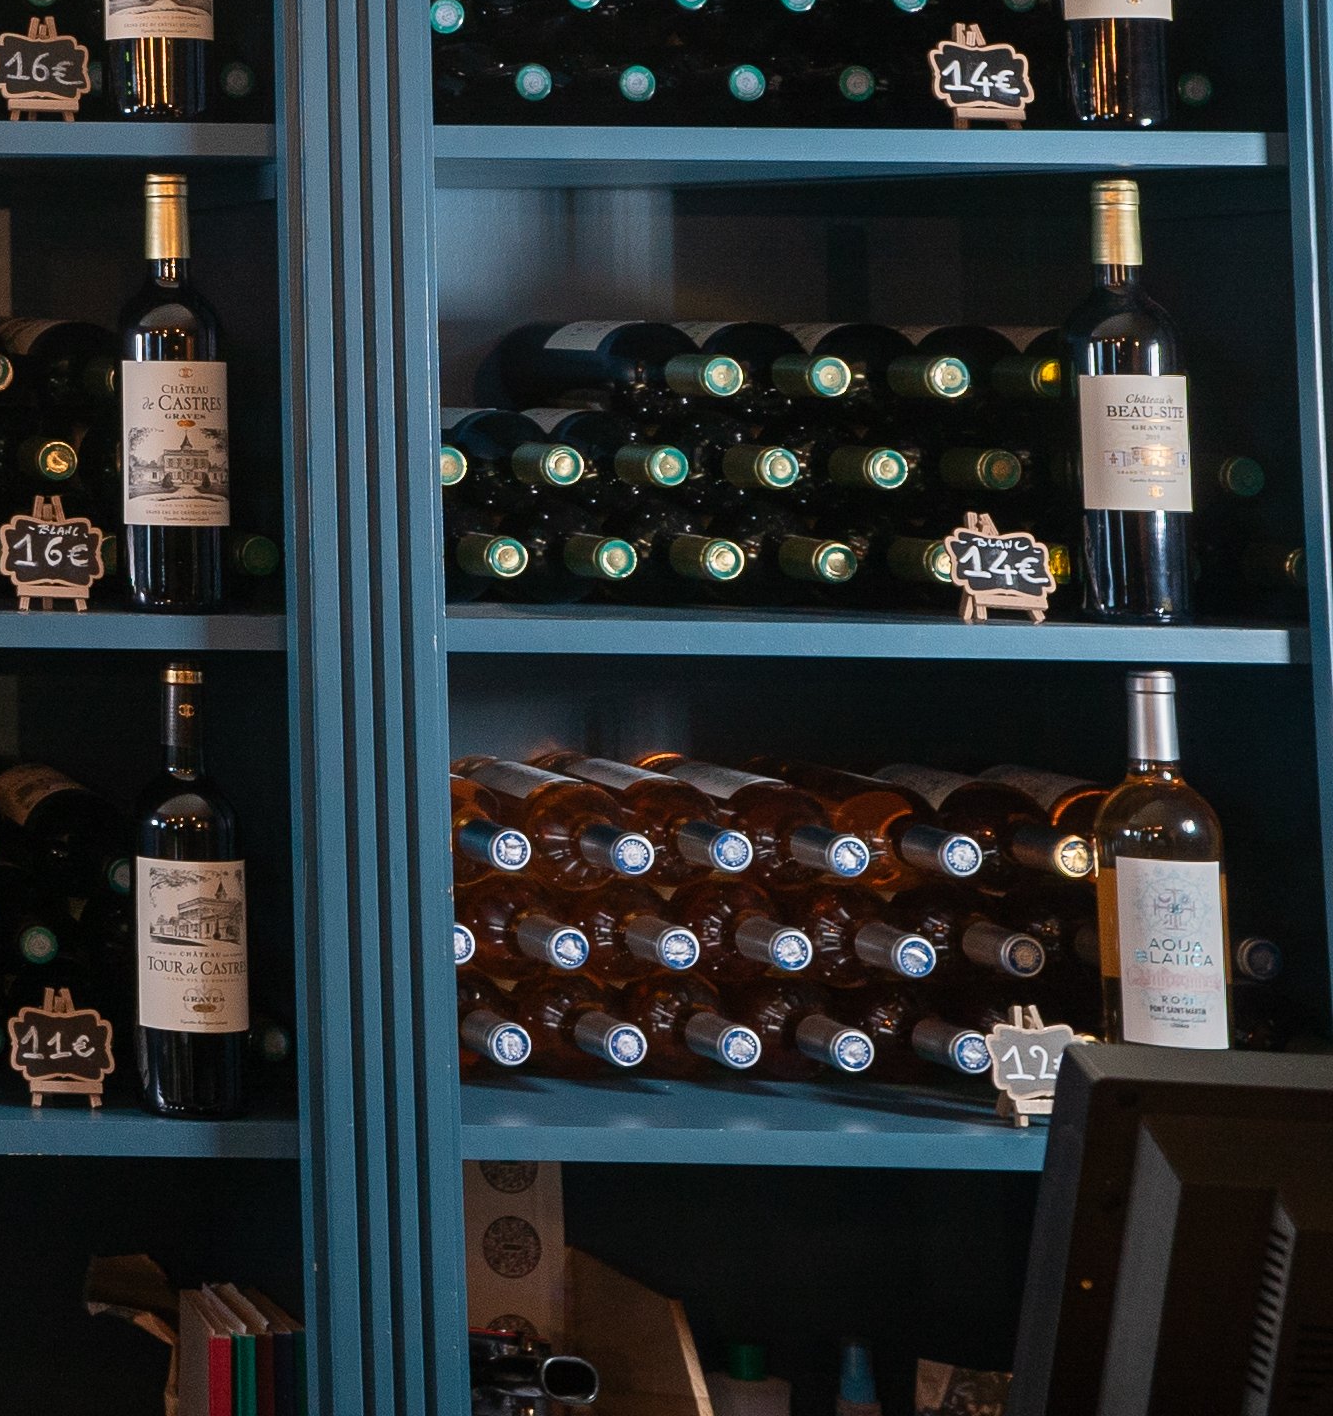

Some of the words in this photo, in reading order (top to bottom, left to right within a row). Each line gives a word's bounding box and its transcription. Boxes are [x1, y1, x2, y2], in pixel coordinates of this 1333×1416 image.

[4, 51, 85, 86] 16€
[941, 59, 1021, 98] 14€
[161, 383, 209, 395] CHÂTEAU
[142, 396, 155, 411] de
[158, 394, 222, 413] CASTRES
[1125, 393, 1166, 405] Château
[164, 413, 206, 421] GRAVES
[1106, 405, 1185, 419] BEAU-SITE
[1131, 424, 1172, 432] GRAVES
[36, 523, 81, 537] BLANC
[12, 534, 90, 568] 16€
[971, 536, 1030, 552] BLANC
[959, 546, 1049, 588] 14€
[147, 955, 186, 976] TOUR
[186, 962, 198, 976] de
[19, 1031, 97, 1060] 11€
